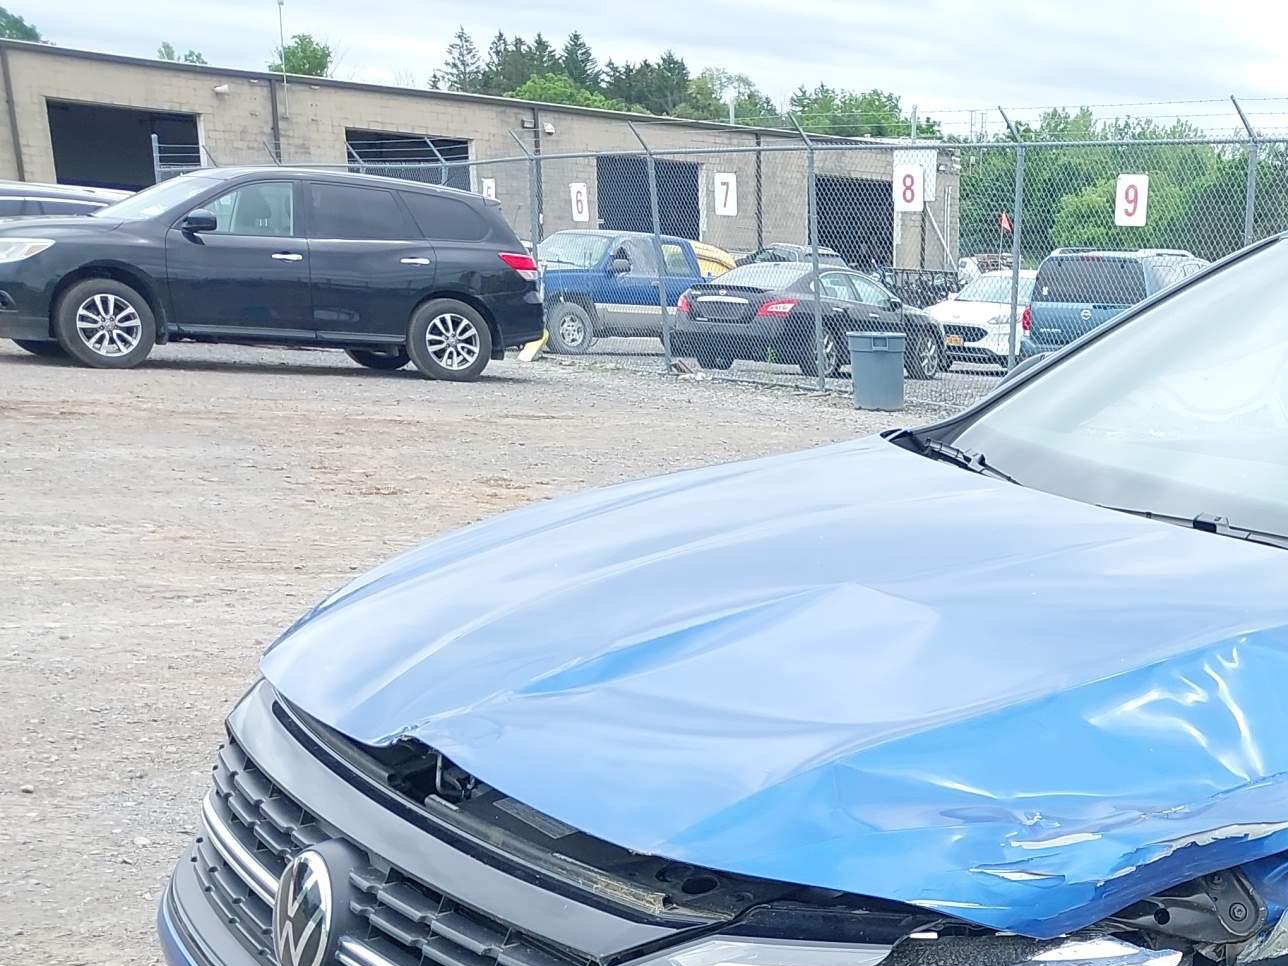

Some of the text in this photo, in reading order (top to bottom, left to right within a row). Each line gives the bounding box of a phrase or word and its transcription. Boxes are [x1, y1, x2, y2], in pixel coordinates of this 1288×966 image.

[575, 190, 584, 215] 6
[720, 181, 731, 209] 7
[902, 174, 915, 203] 8
[1123, 184, 1139, 217] 9
